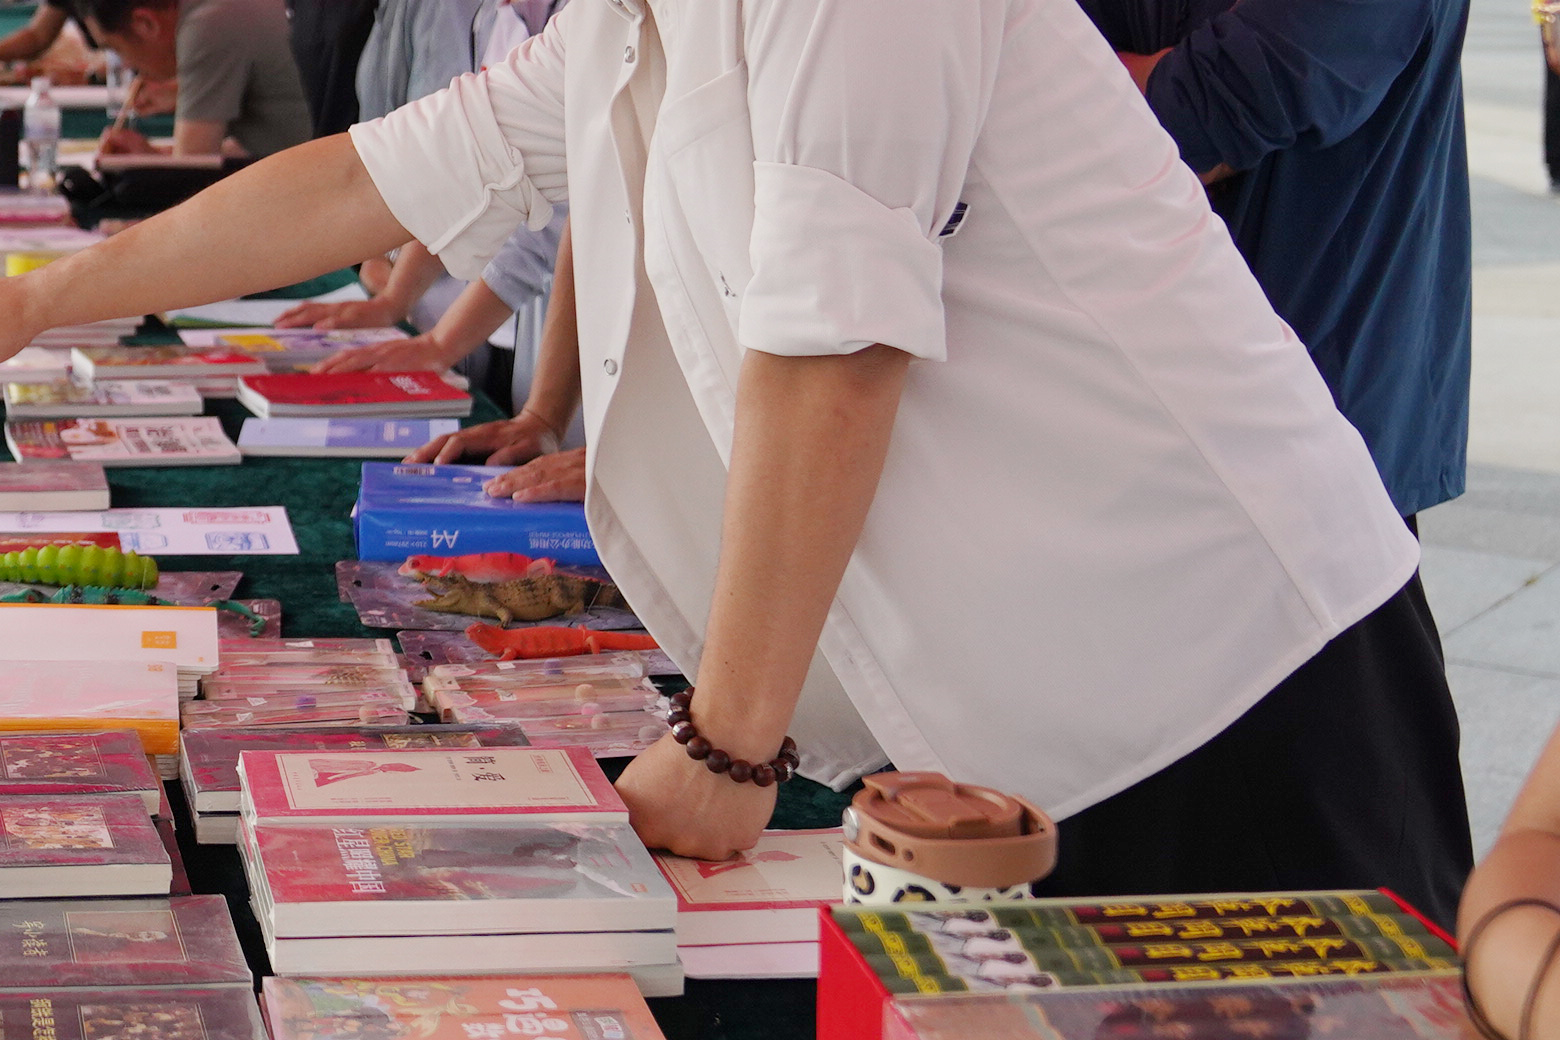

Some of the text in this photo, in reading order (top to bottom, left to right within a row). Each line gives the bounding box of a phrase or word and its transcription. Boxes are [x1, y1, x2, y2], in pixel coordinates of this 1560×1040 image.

[431, 530, 459, 549] A4
[529, 537, 595, 550] 功能办公用纸
[463, 756, 506, 781] 简·爱
[332, 828, 387, 893] 红星照耀中国
